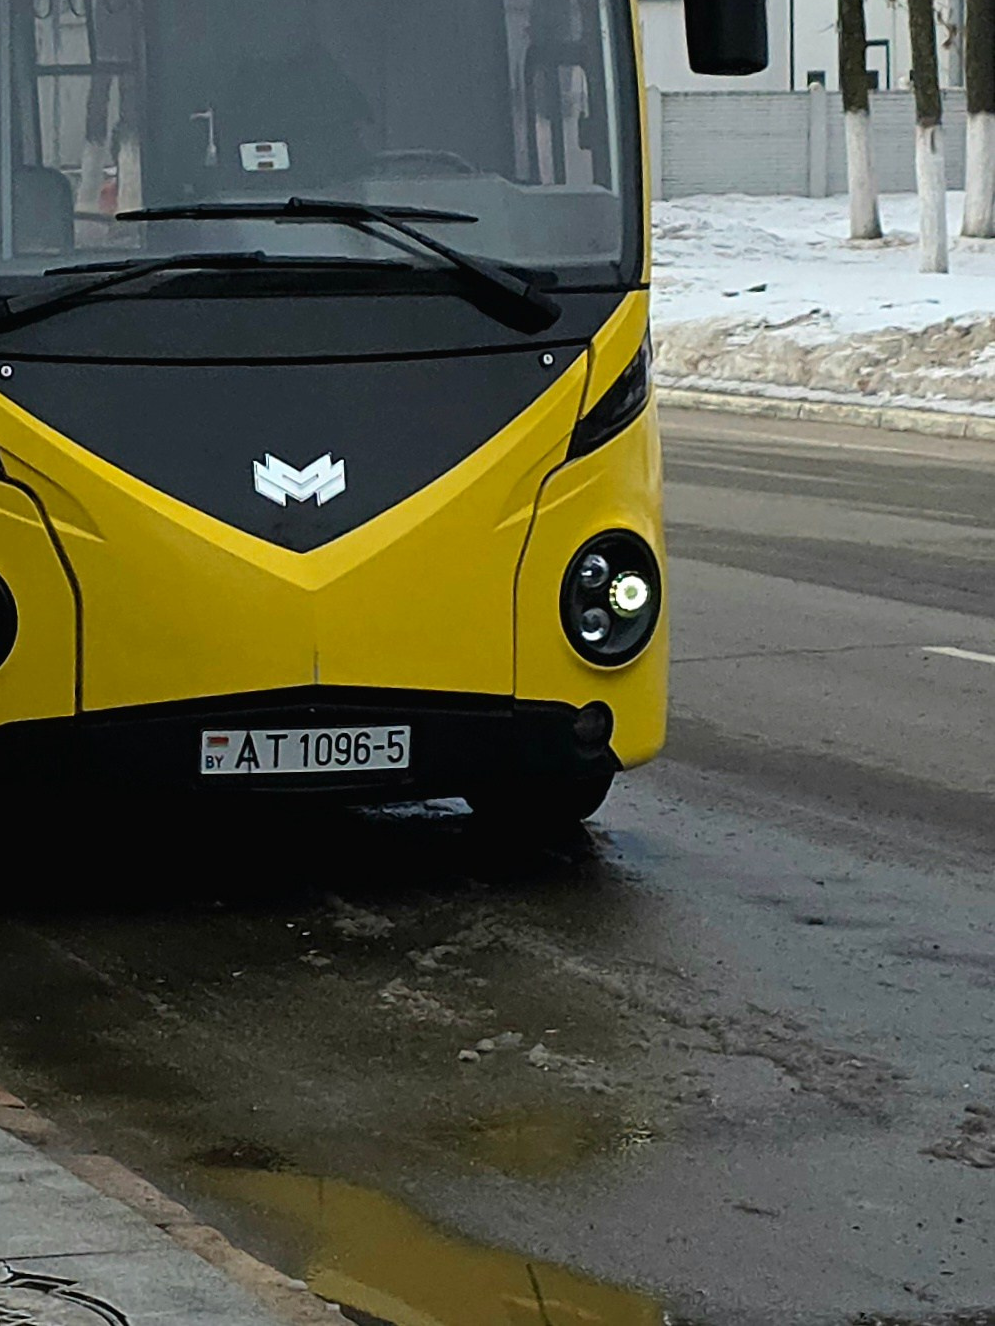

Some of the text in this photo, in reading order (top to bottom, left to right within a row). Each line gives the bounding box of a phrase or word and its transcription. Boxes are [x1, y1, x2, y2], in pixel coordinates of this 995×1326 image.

[205, 755, 224, 769] BY
[234, 730, 405, 769] AT 1096-5
